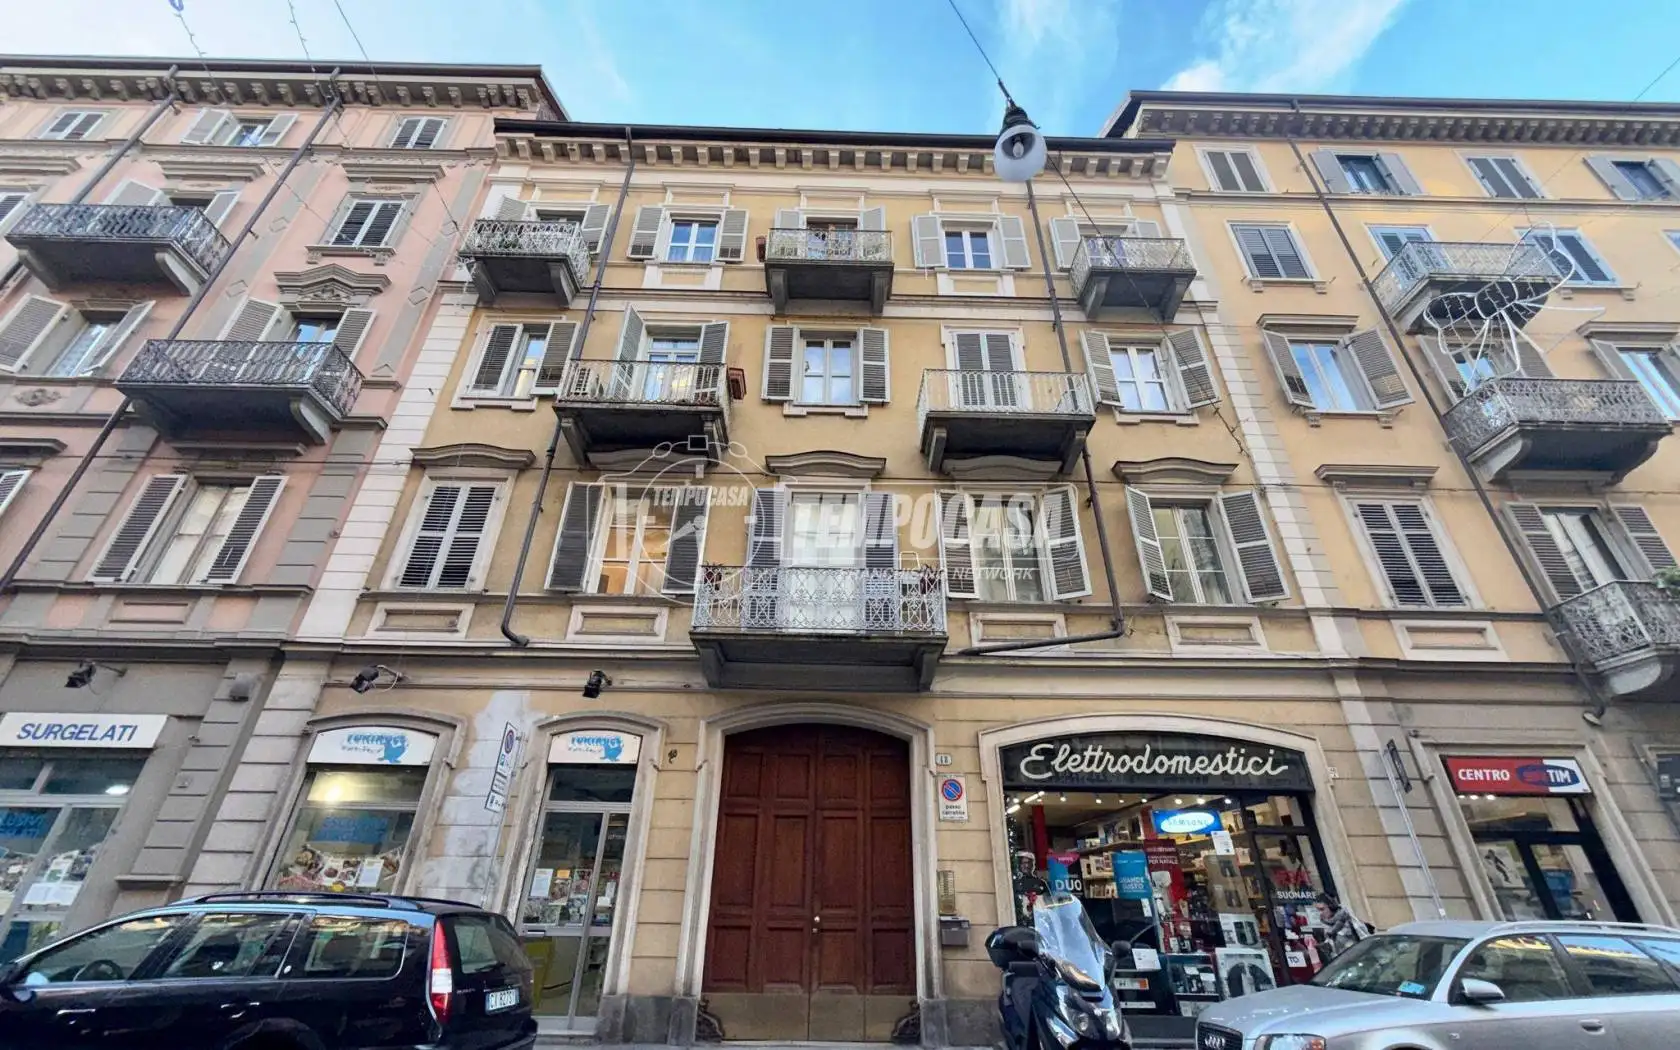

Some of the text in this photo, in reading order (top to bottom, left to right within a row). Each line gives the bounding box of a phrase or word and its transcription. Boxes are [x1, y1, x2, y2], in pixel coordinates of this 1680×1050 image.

[17, 723, 138, 741] SURGELATI
[1019, 743, 1289, 779] Elettrodomestici
[1458, 768, 1572, 783] CENTRO TIM
[1055, 879, 1082, 891] DUO
[1277, 891, 1317, 899] SUONARE
